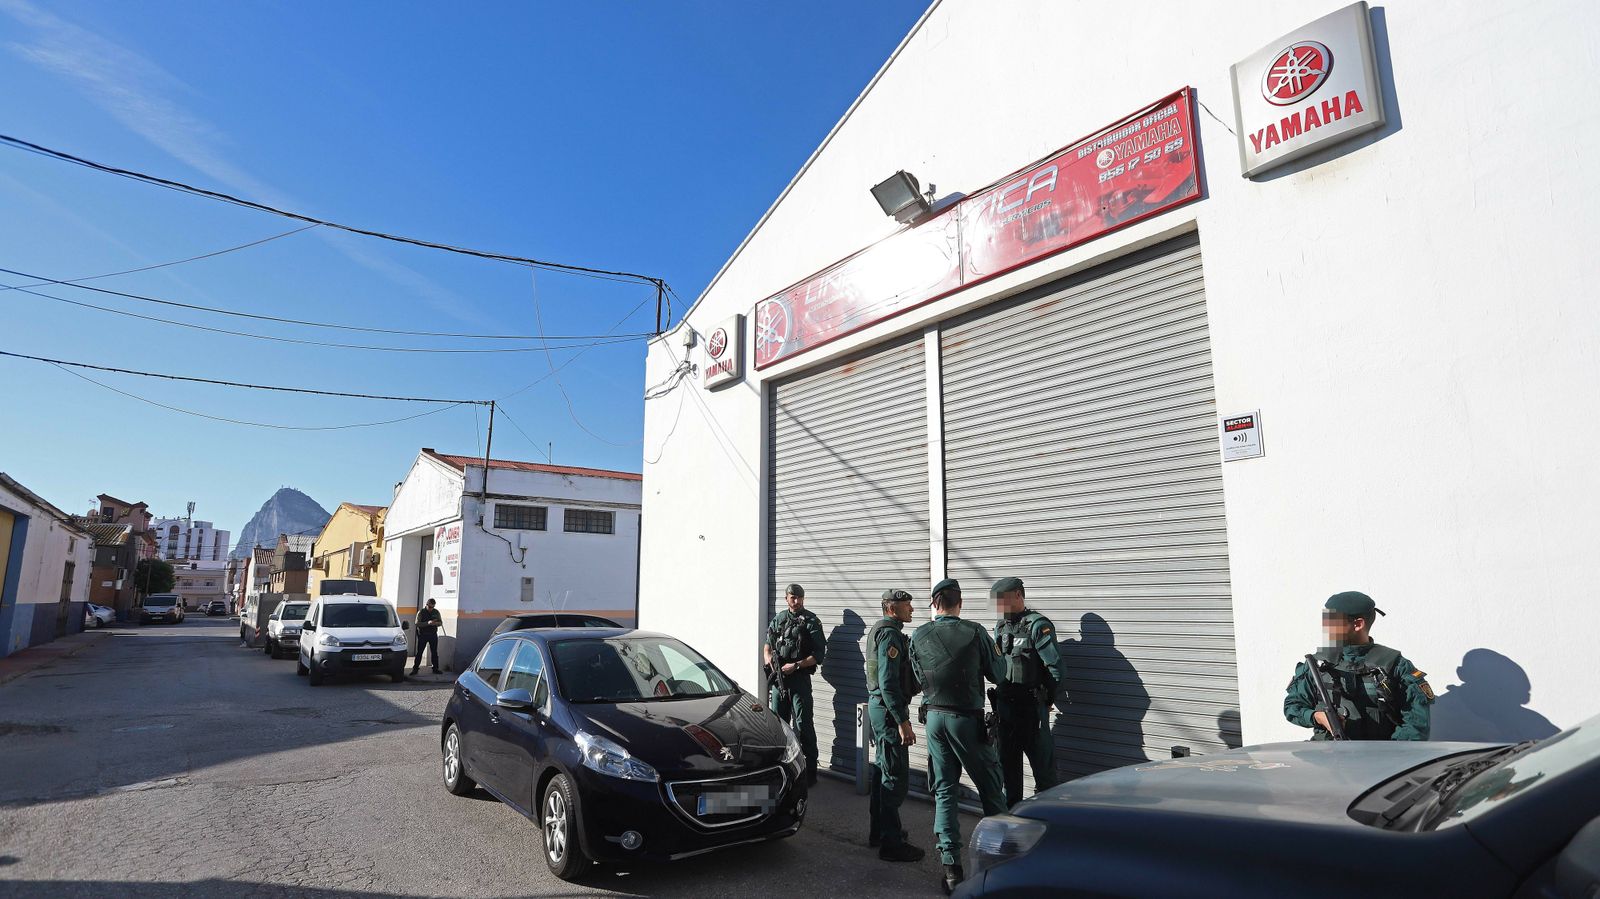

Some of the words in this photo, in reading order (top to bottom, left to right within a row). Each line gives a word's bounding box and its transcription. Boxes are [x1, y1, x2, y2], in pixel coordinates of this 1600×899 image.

[1077, 121, 1142, 159] DISTRIBUIDOR
[1143, 103, 1178, 128] OFICIAL
[1249, 90, 1364, 154] YAMAHA
[1113, 117, 1182, 161] YAMAHA
[1128, 157, 1140, 170] 17
[704, 358, 733, 380] YAMAHA
[1226, 417, 1251, 426] SECTOR
